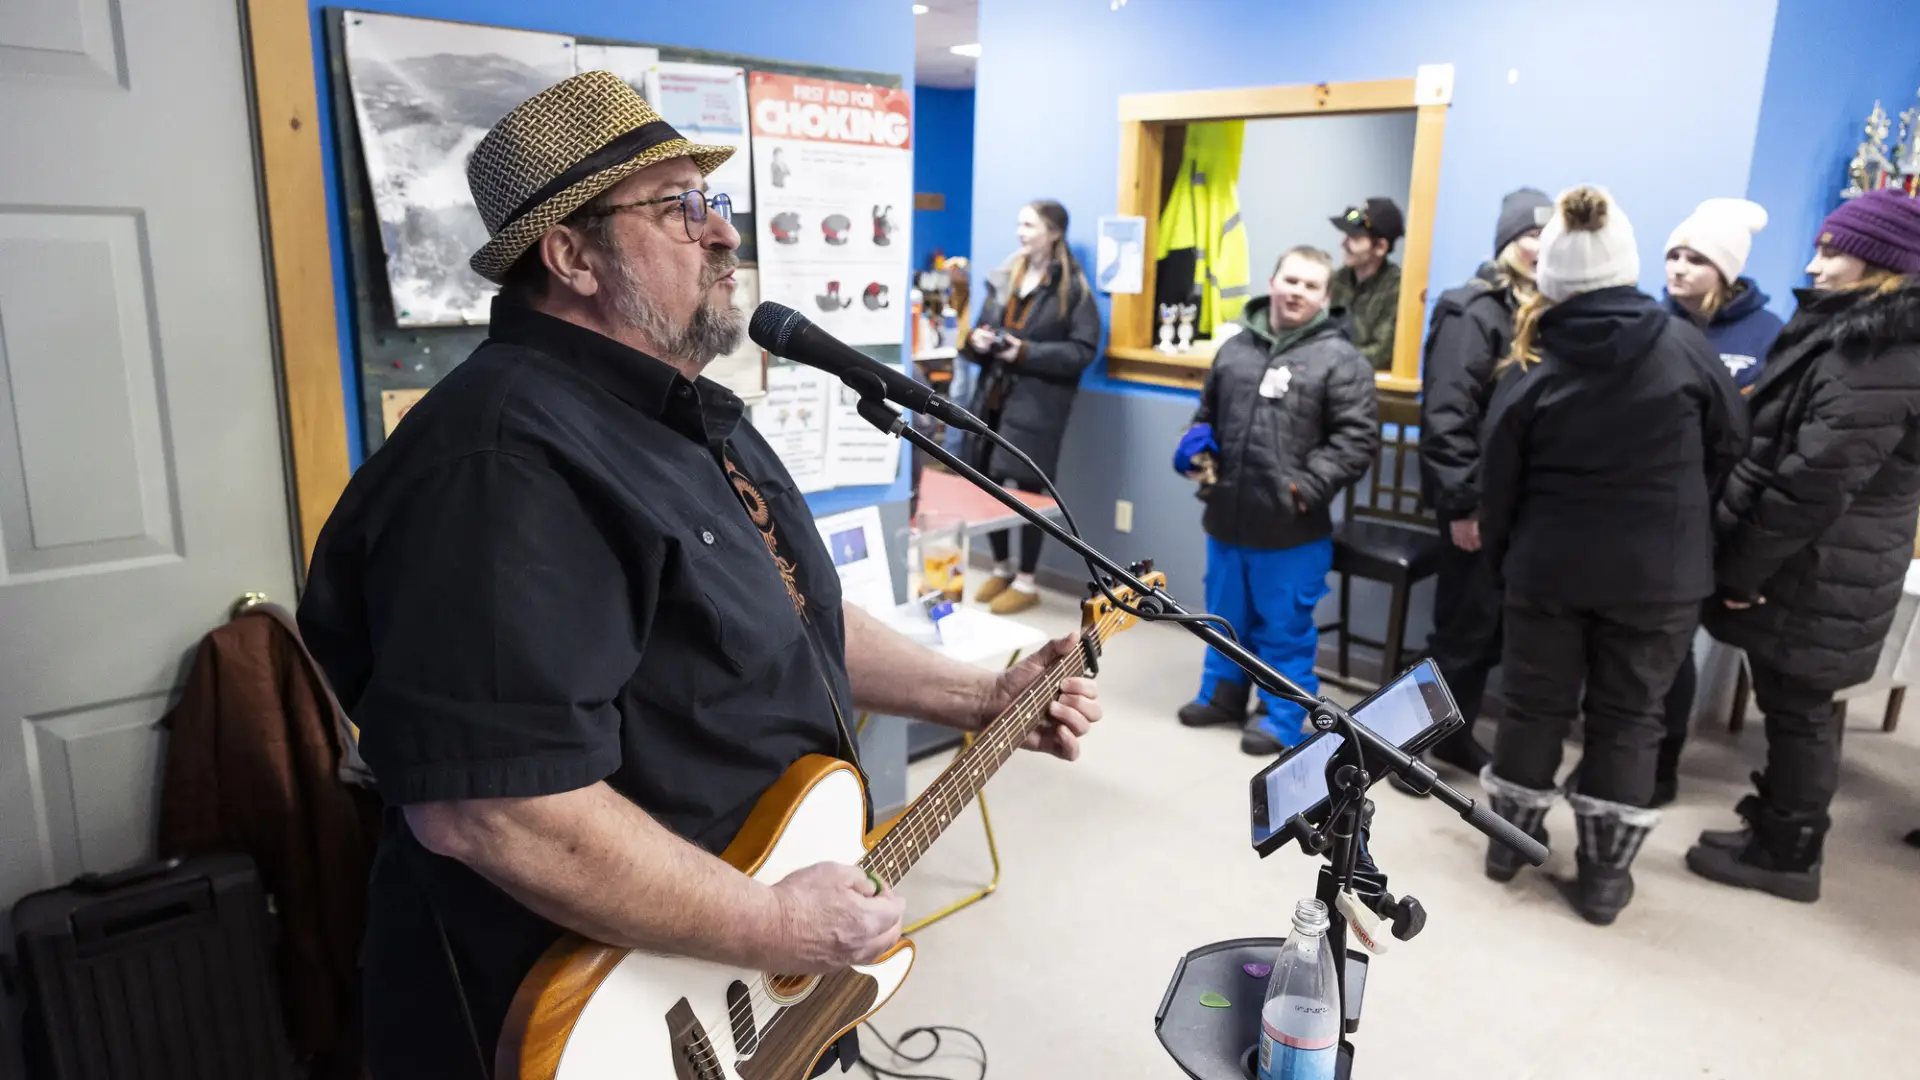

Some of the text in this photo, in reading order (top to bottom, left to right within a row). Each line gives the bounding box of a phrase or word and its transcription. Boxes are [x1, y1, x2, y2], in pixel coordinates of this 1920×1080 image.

[794, 85, 874, 107] FIRST AID FOR
[756, 100, 908, 146] CHOKING
